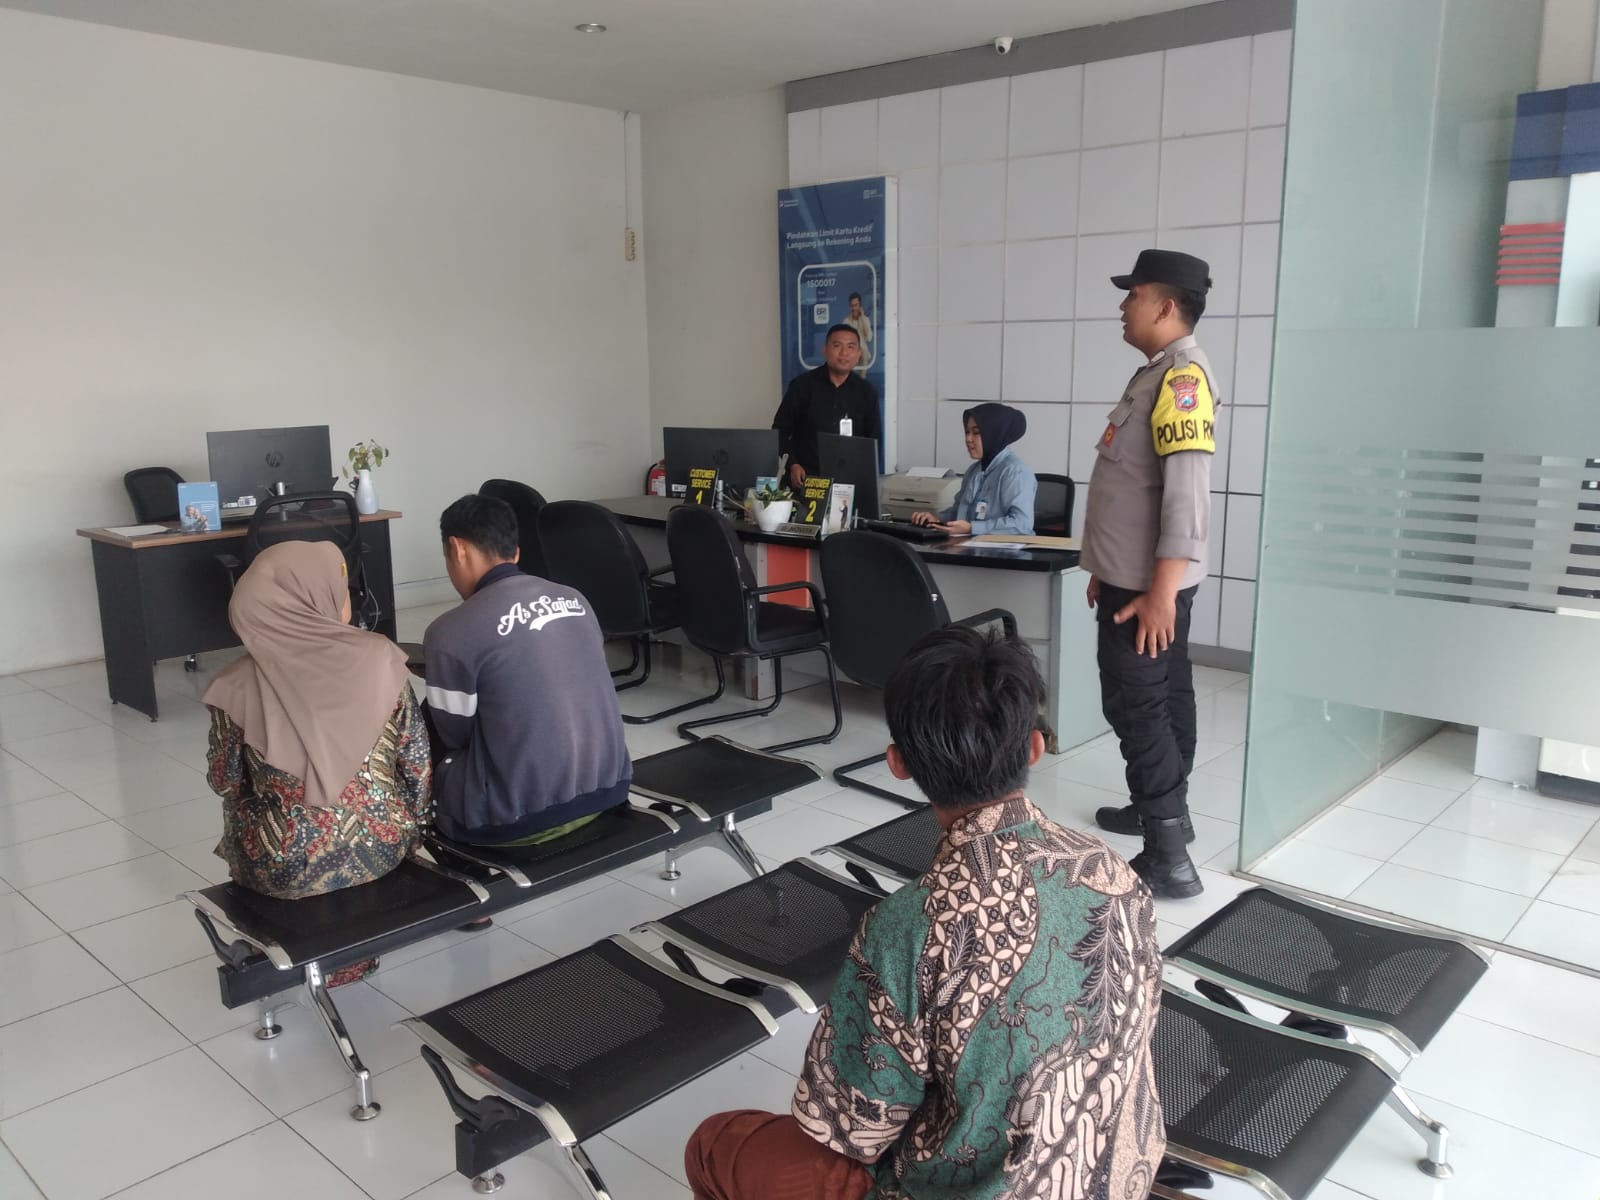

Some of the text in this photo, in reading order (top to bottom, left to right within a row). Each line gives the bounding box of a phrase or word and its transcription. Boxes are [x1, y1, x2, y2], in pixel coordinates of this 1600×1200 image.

[819, 229, 834, 237] Limit
[835, 227, 852, 235] Kartu
[853, 224, 873, 233] Kredit
[1157, 419, 1199, 447] POLISI
[690, 469, 716, 479] CUSTOMER
[691, 479, 712, 489] SERVICE
[804, 478, 830, 489] CUSTOMER
[696, 490, 703, 504] 1
[804, 488, 826, 499] SERVICE
[806, 500, 817, 522] 2
[497, 602, 531, 635] As
